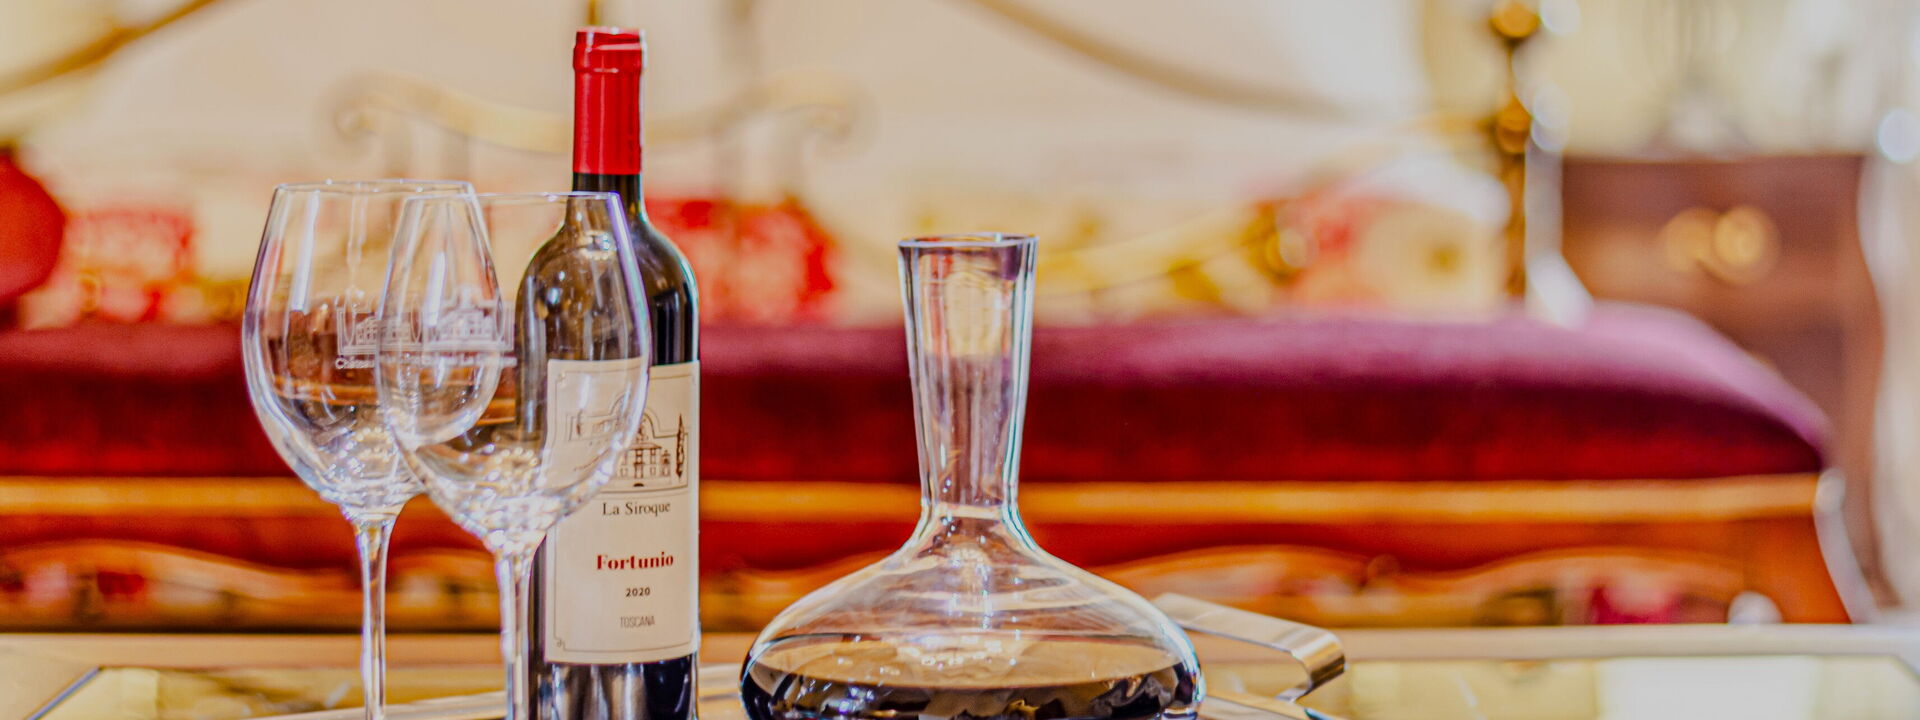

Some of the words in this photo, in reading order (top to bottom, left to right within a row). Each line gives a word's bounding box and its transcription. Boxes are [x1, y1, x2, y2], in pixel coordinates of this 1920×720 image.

[602, 502, 620, 515] La
[625, 502, 671, 517] Siroque
[596, 551, 674, 570] Fortunio
[626, 586, 651, 597] 2020
[620, 615, 656, 628] TOSCANA
